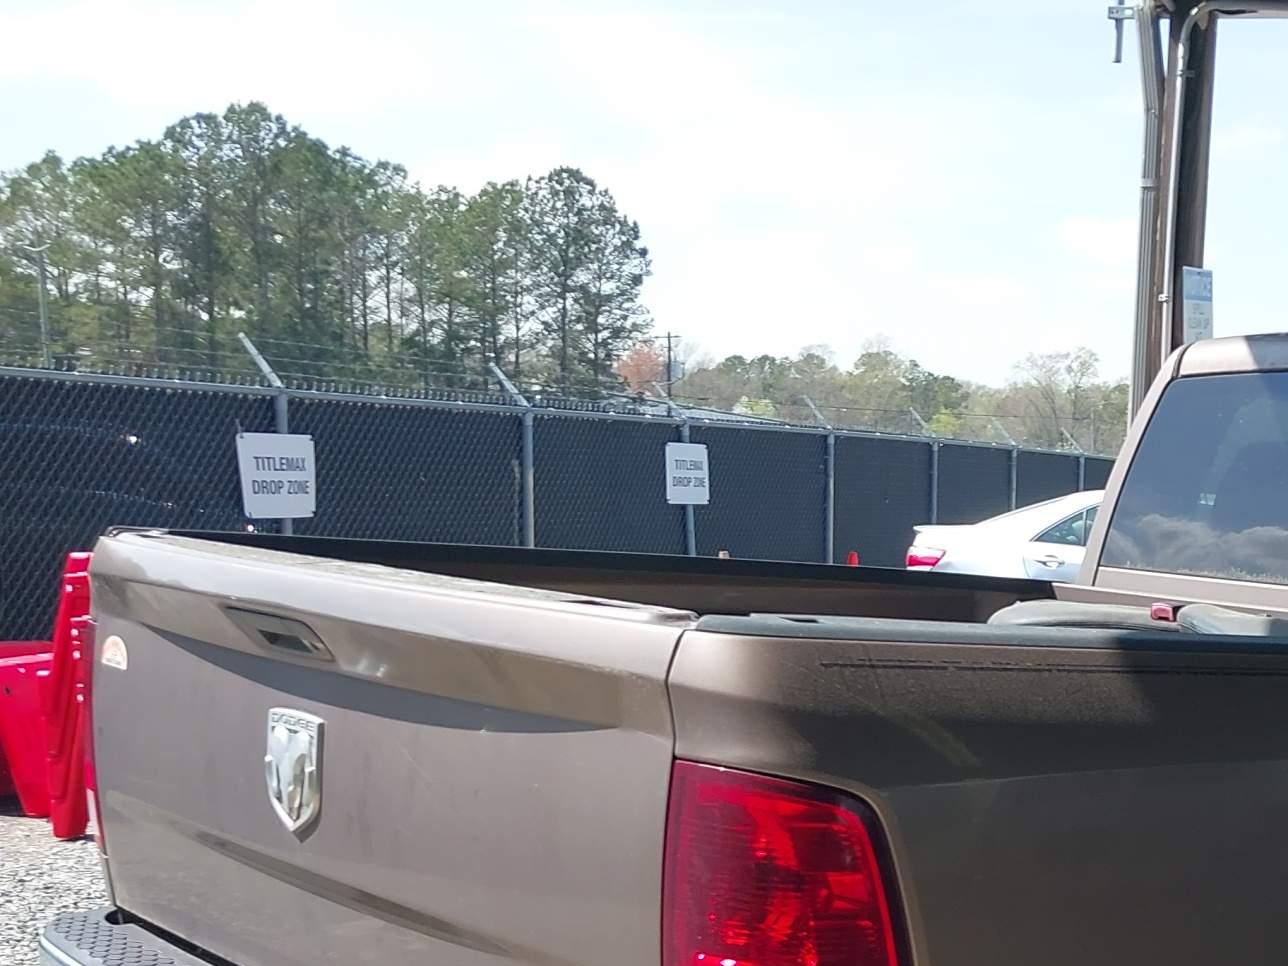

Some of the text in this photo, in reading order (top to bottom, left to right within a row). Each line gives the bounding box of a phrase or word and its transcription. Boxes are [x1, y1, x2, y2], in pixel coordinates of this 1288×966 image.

[253, 456, 307, 471] TITLEMAX
[673, 459, 704, 471] TITLEMAX
[252, 480, 310, 495] DROP ZONE
[672, 476, 692, 487] DROP
[271, 712, 315, 732] DODGE
